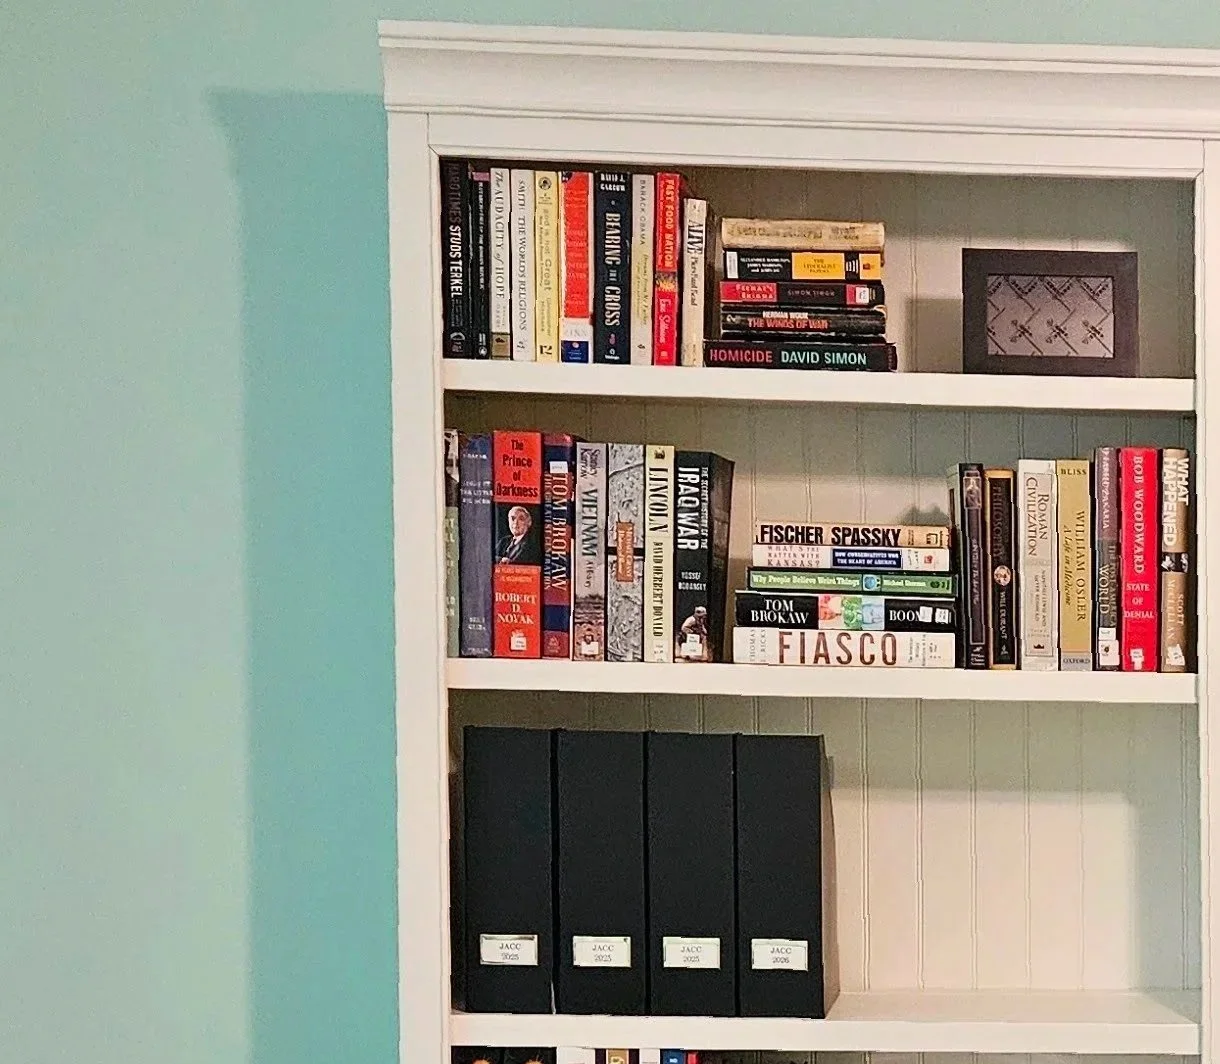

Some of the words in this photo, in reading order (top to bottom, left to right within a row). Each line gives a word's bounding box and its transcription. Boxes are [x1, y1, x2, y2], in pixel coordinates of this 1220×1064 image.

[665, 179, 675, 202] FAST
[495, 189, 504, 250] AUDACITY
[665, 205, 674, 231] FOOD
[450, 225, 462, 258] STUDS
[604, 212, 621, 265] BEARING
[664, 234, 674, 268] NATION
[687, 220, 703, 254] ALIVE
[494, 253, 504, 265] of
[450, 261, 463, 298] TERKEL
[495, 267, 504, 299] HOPE
[604, 286, 621, 326] CROSS
[749, 318, 764, 327] THE
[766, 319, 794, 328] WINDS
[795, 320, 808, 329] OF
[809, 320, 828, 329] WAR
[710, 350, 773, 363] HOMICIDE
[781, 351, 820, 363] DAVID
[824, 352, 867, 365] SIMON
[511, 440, 523, 450] The
[503, 455, 532, 468] Prince
[513, 471, 521, 481] of
[1133, 456, 1144, 484] BOB
[496, 485, 538, 498] Darkness
[551, 474, 568, 510] TOM
[677, 467, 700, 507] IRAQ
[1177, 457, 1189, 506] WHAT
[649, 467, 668, 533] LINCOLN
[1163, 457, 1177, 546] HAPPENED
[582, 489, 597, 556] VIETNAM
[678, 513, 700, 549] WAR
[1026, 477, 1038, 556] CIVILIZATION
[1038, 494, 1049, 540] ROMAN
[1133, 489, 1145, 574] WOODWARD
[760, 525, 823, 544] FISCHER
[831, 526, 901, 546] SPASSKY
[1076, 511, 1085, 571] WILLIAM
[552, 518, 568, 591] BROKAW
[653, 542, 663, 564] DAVID
[653, 566, 664, 604] HERBERT
[752, 574, 767, 583] Why
[769, 575, 791, 584] People
[793, 576, 815, 584] Believe
[837, 577, 859, 587] Things
[1099, 564, 1110, 614] WORLD
[1127, 583, 1150, 592] STATE
[496, 593, 537, 604] ROBERT
[765, 599, 794, 611] TOM
[1076, 578, 1086, 621] OSLER
[1133, 597, 1143, 605] OF
[1176, 594, 1185, 625] SCOTT
[498, 614, 534, 625] NOVAK
[653, 606, 663, 637] DONALD
[751, 610, 809, 624] BROKAW
[1000, 609, 1008, 639] DURANT
[779, 632, 897, 665] FIASCO
